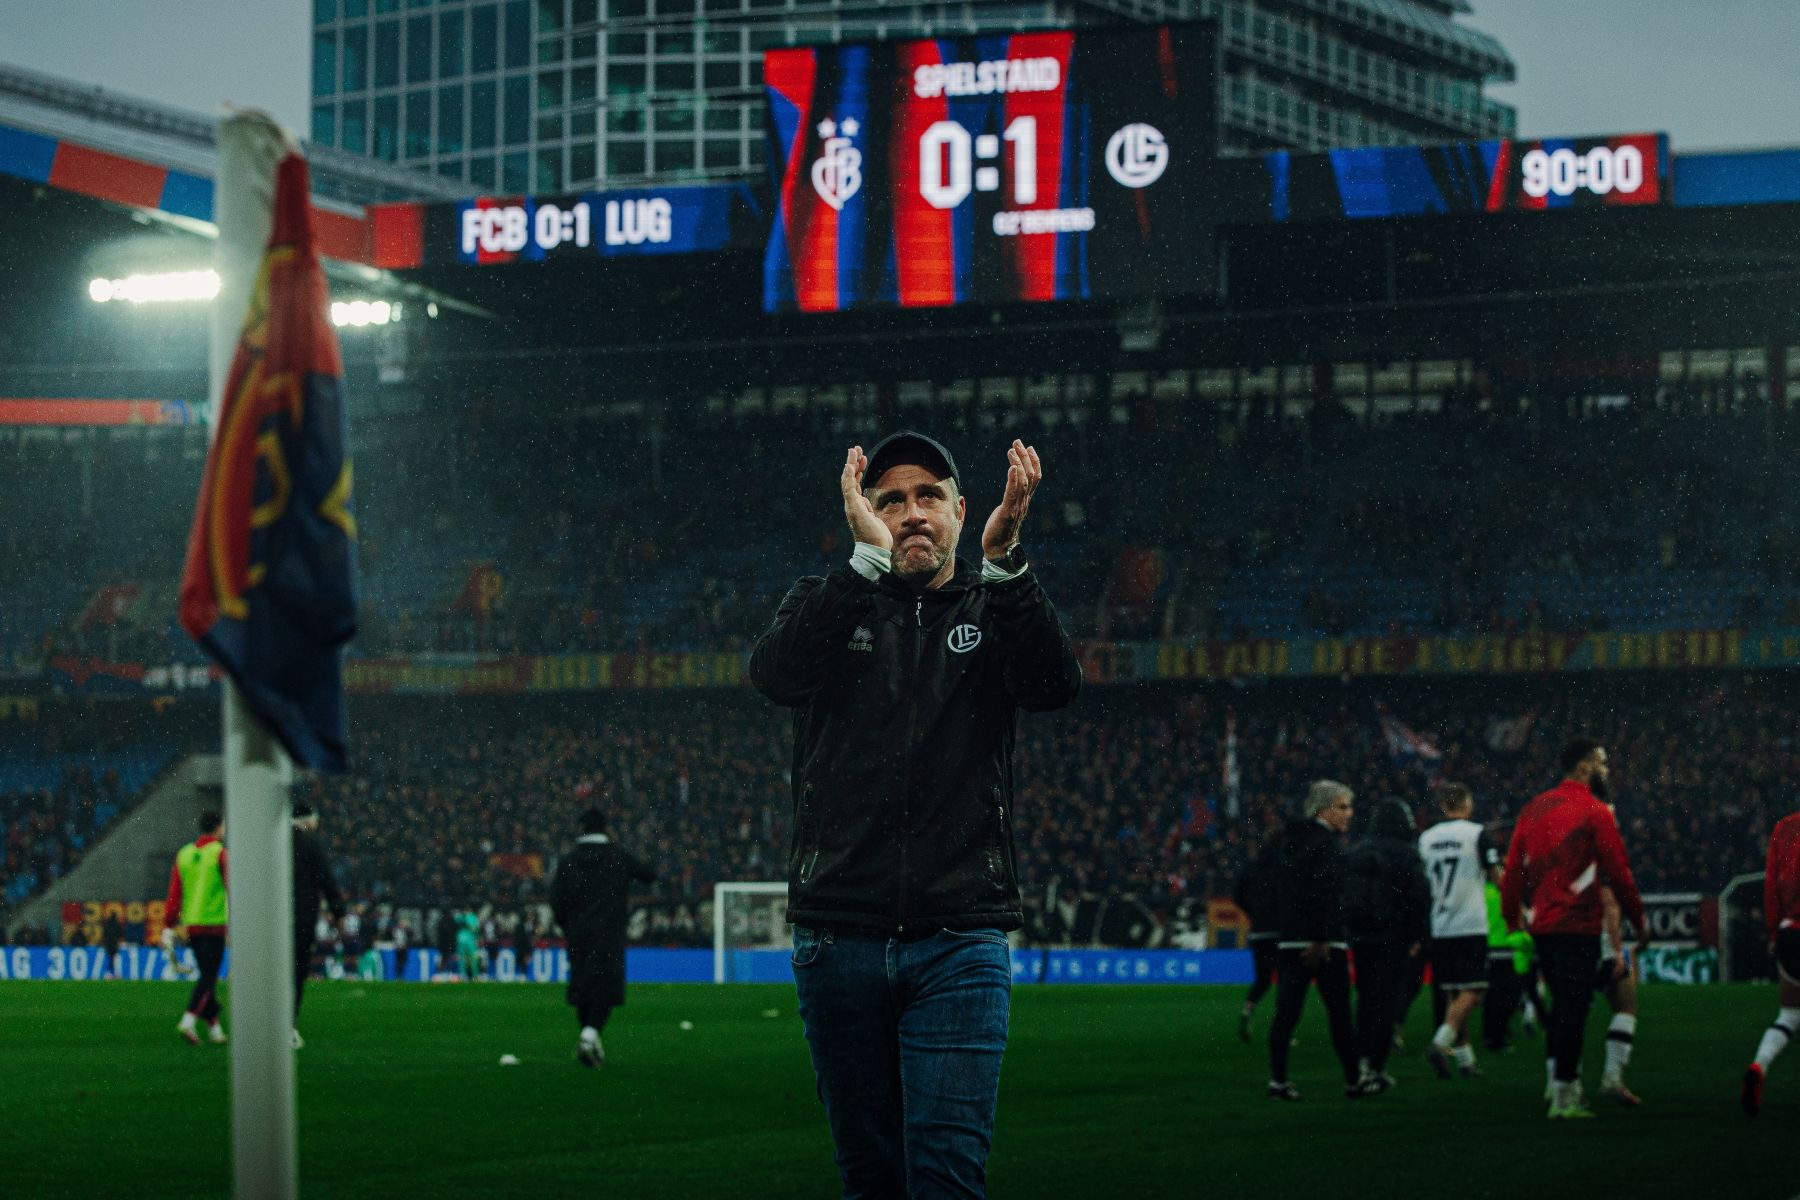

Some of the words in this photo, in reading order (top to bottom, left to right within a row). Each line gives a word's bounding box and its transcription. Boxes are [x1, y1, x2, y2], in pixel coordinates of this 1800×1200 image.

[913, 57, 1061, 98] SPIELSTAND
[919, 116, 1038, 209] 0:1
[1521, 144, 1644, 198] 90:00
[462, 206, 529, 254] FCB
[534, 203, 590, 249] 0:1
[605, 197, 672, 246] LUG
[1432, 855, 1459, 897] 17
